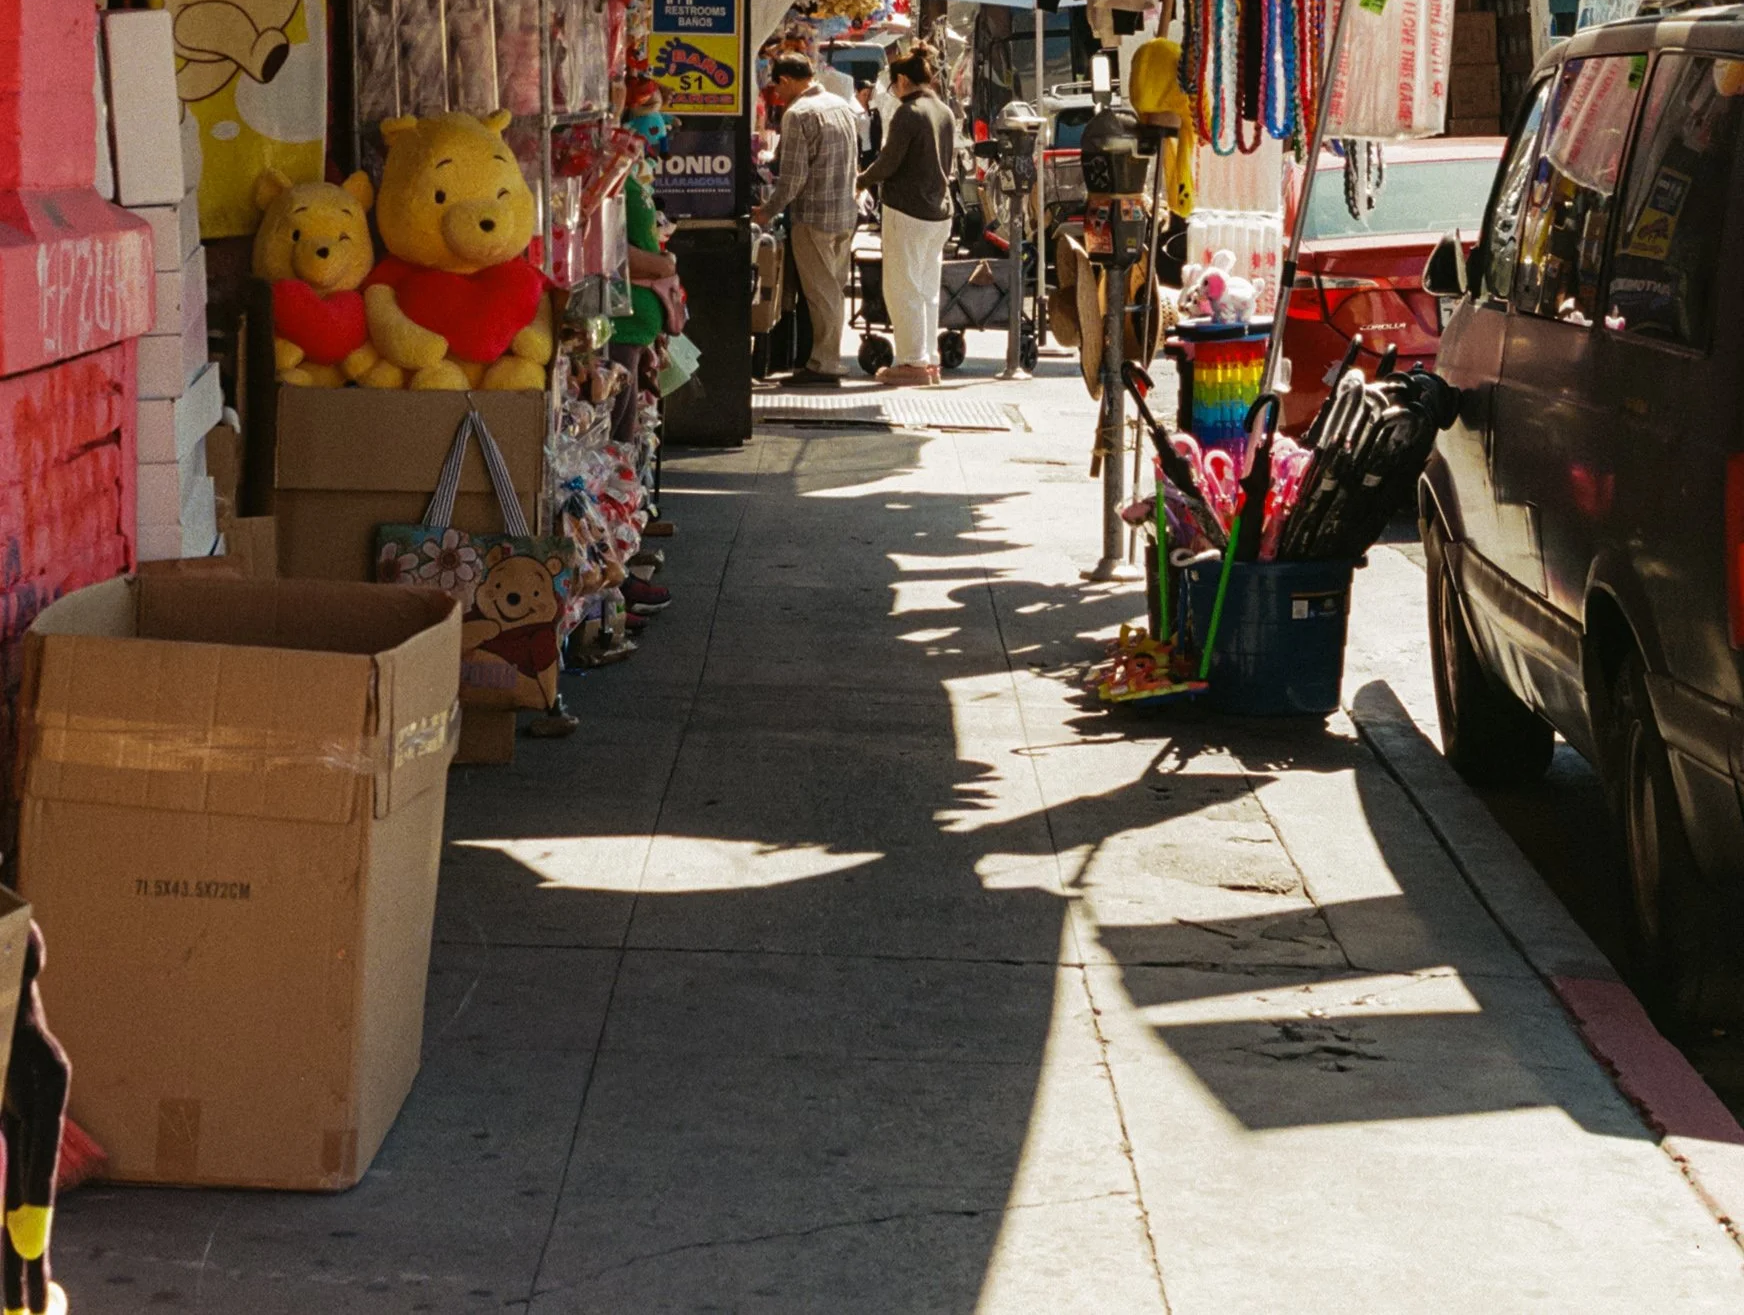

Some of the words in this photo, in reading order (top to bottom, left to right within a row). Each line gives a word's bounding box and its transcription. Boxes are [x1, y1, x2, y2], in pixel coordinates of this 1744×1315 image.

[664, 5, 726, 16] RESTROOMS
[1402, 8, 1416, 47] LOVE
[1400, 49, 1415, 79] THIS
[679, 75, 703, 91] $1
[1360, 322, 1407, 331] COROLLA
